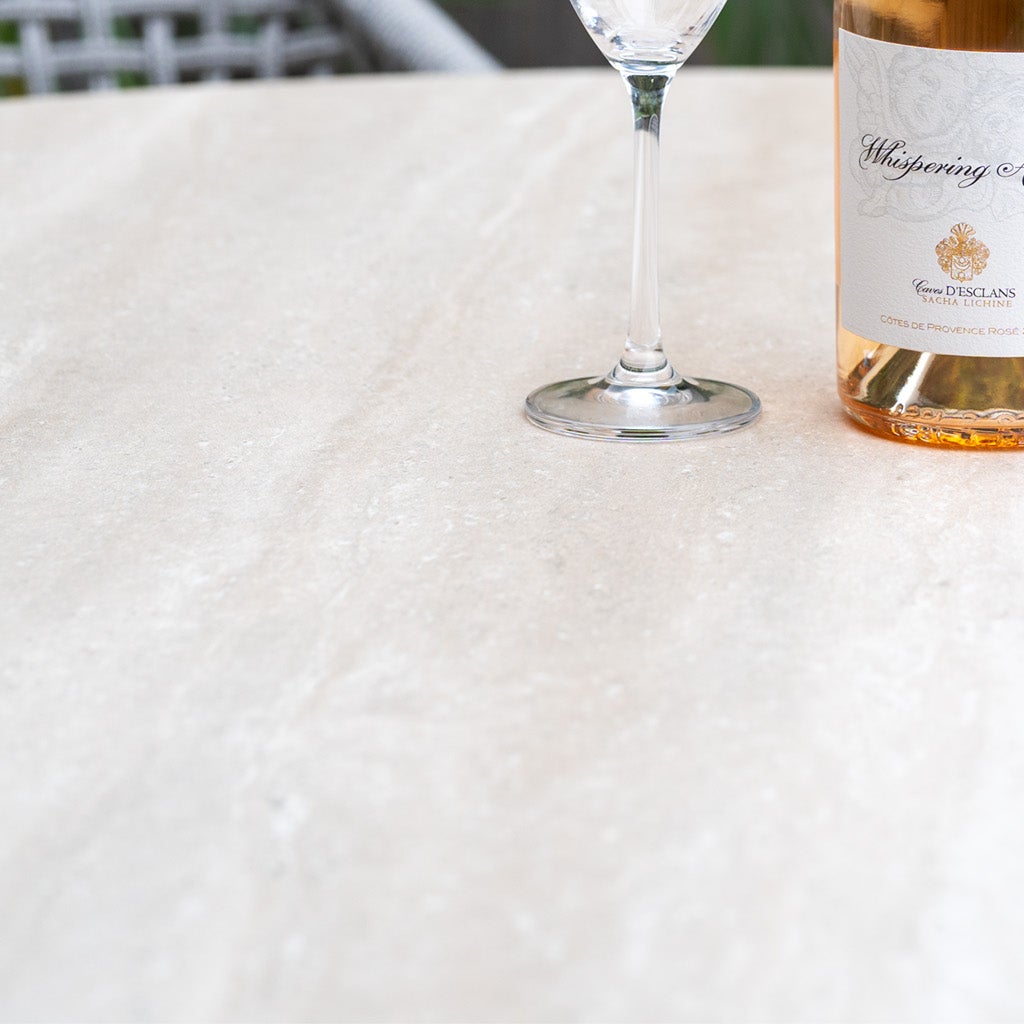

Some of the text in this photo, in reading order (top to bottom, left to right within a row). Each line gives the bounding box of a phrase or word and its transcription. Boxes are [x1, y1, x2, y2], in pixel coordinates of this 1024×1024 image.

[858, 133, 991, 188] Whispering
[912, 278, 1017, 298] Caves D'ESCLANS
[921, 295, 1013, 308] SACHA LICHINE
[880, 314, 910, 328] CÔTES
[911, 321, 926, 331] DE
[927, 322, 986, 336] PROVENCE
